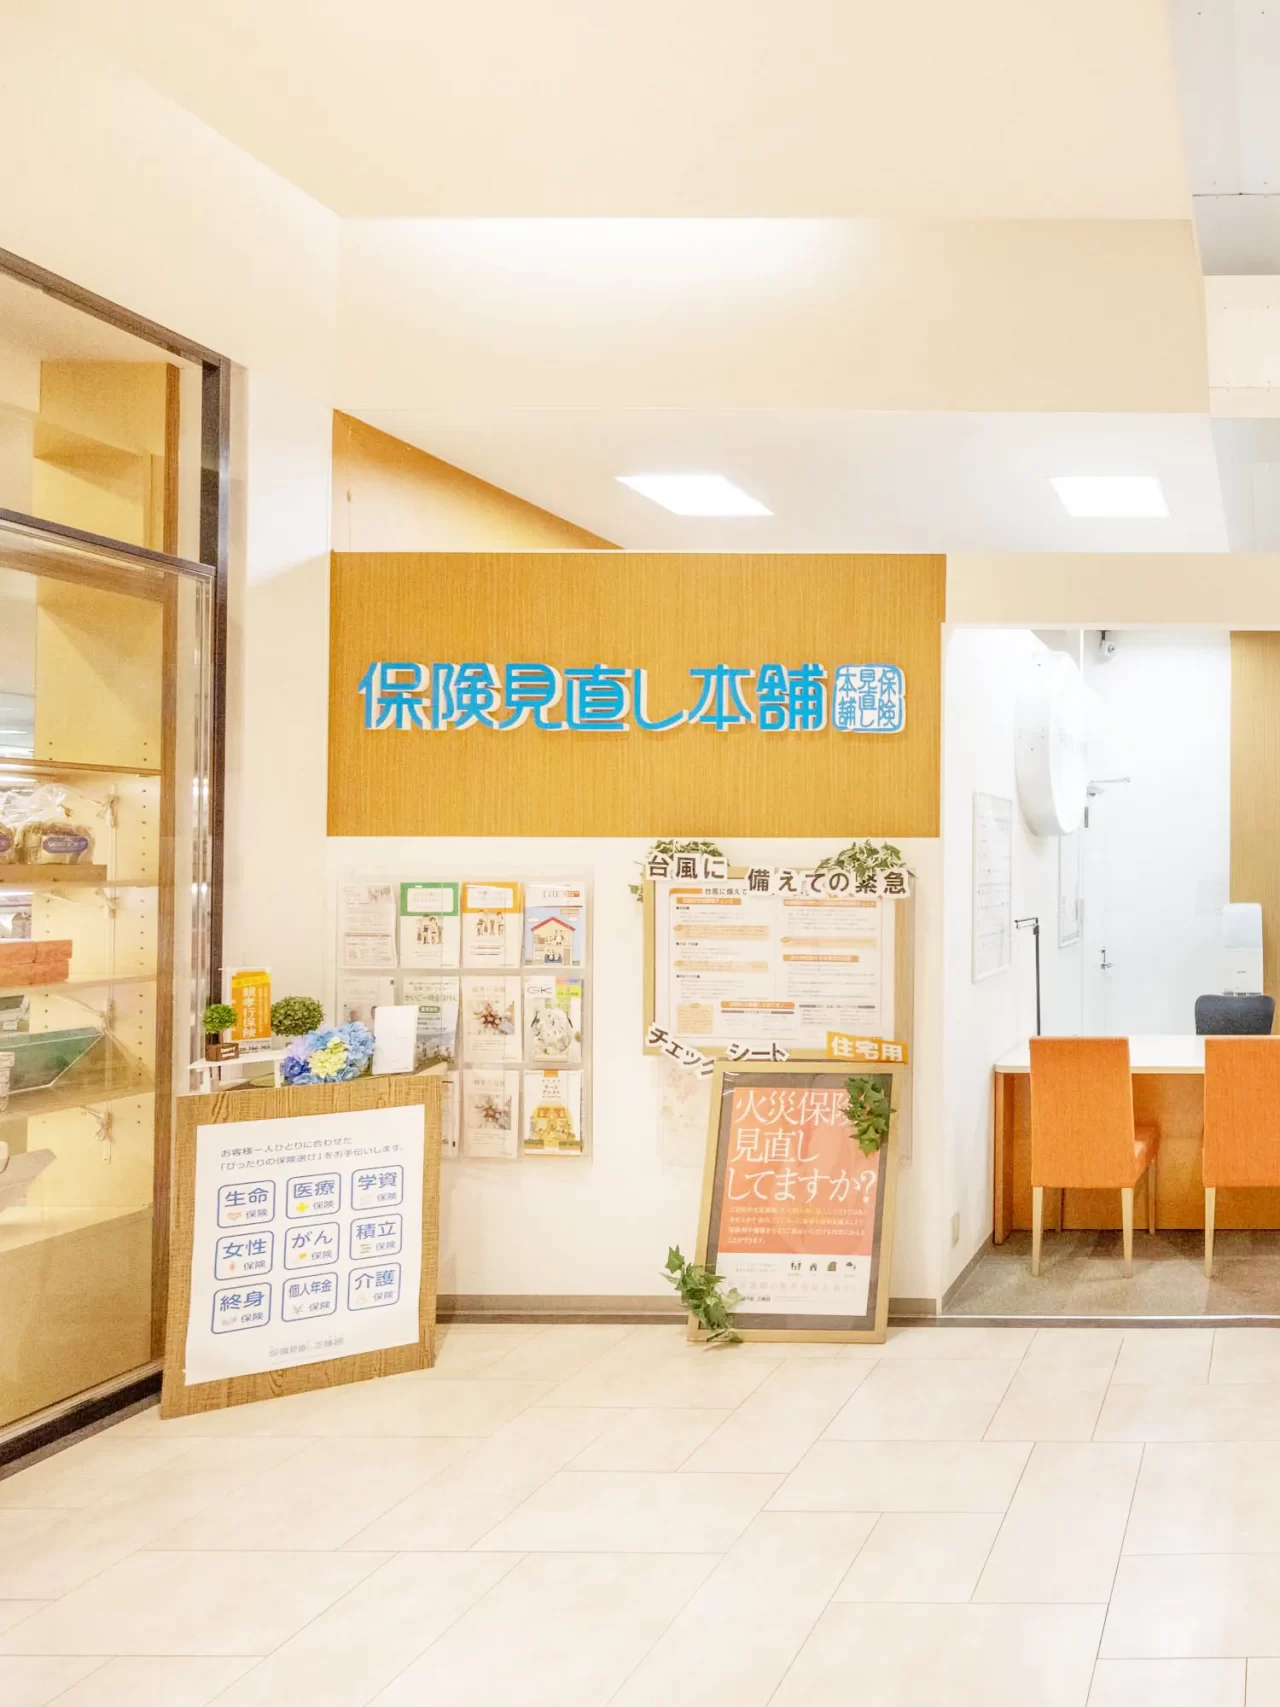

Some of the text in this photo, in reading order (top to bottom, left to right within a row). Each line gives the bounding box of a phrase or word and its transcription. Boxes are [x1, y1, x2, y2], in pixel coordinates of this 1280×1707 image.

[357, 661, 828, 732] 保険見直し本舗
[838, 667, 857, 728] 本舗
[857, 668, 878, 728] 見直し
[878, 668, 897, 728] 保険
[647, 854, 725, 880] 台風に
[729, 1042, 787, 1063] シート
[830, 1036, 904, 1062] 住宅用
[220, 1136, 353, 1158] お客様一人ひとりに合わせた
[730, 1127, 820, 1163] 見直し
[293, 1180, 336, 1199] 医療
[358, 1172, 397, 1190] 学資
[727, 1166, 878, 1204] してますか?
[224, 1187, 269, 1208] 生命
[312, 1200, 335, 1211] 保険
[377, 1191, 397, 1203] 保険
[245, 1208, 268, 1220] 保険
[291, 1230, 333, 1249] がん
[355, 1221, 396, 1241] 積立
[222, 1238, 267, 1260] 女性
[311, 1250, 333, 1261] 保険
[375, 1240, 397, 1252] 保険
[243, 1259, 266, 1272] 保険
[289, 1279, 333, 1299] 個人年金
[354, 1269, 396, 1290] 介護
[219, 1290, 265, 1312] 終身
[309, 1300, 331, 1312] 保険
[373, 1290, 395, 1302] 保険
[240, 1311, 264, 1324] 保険
